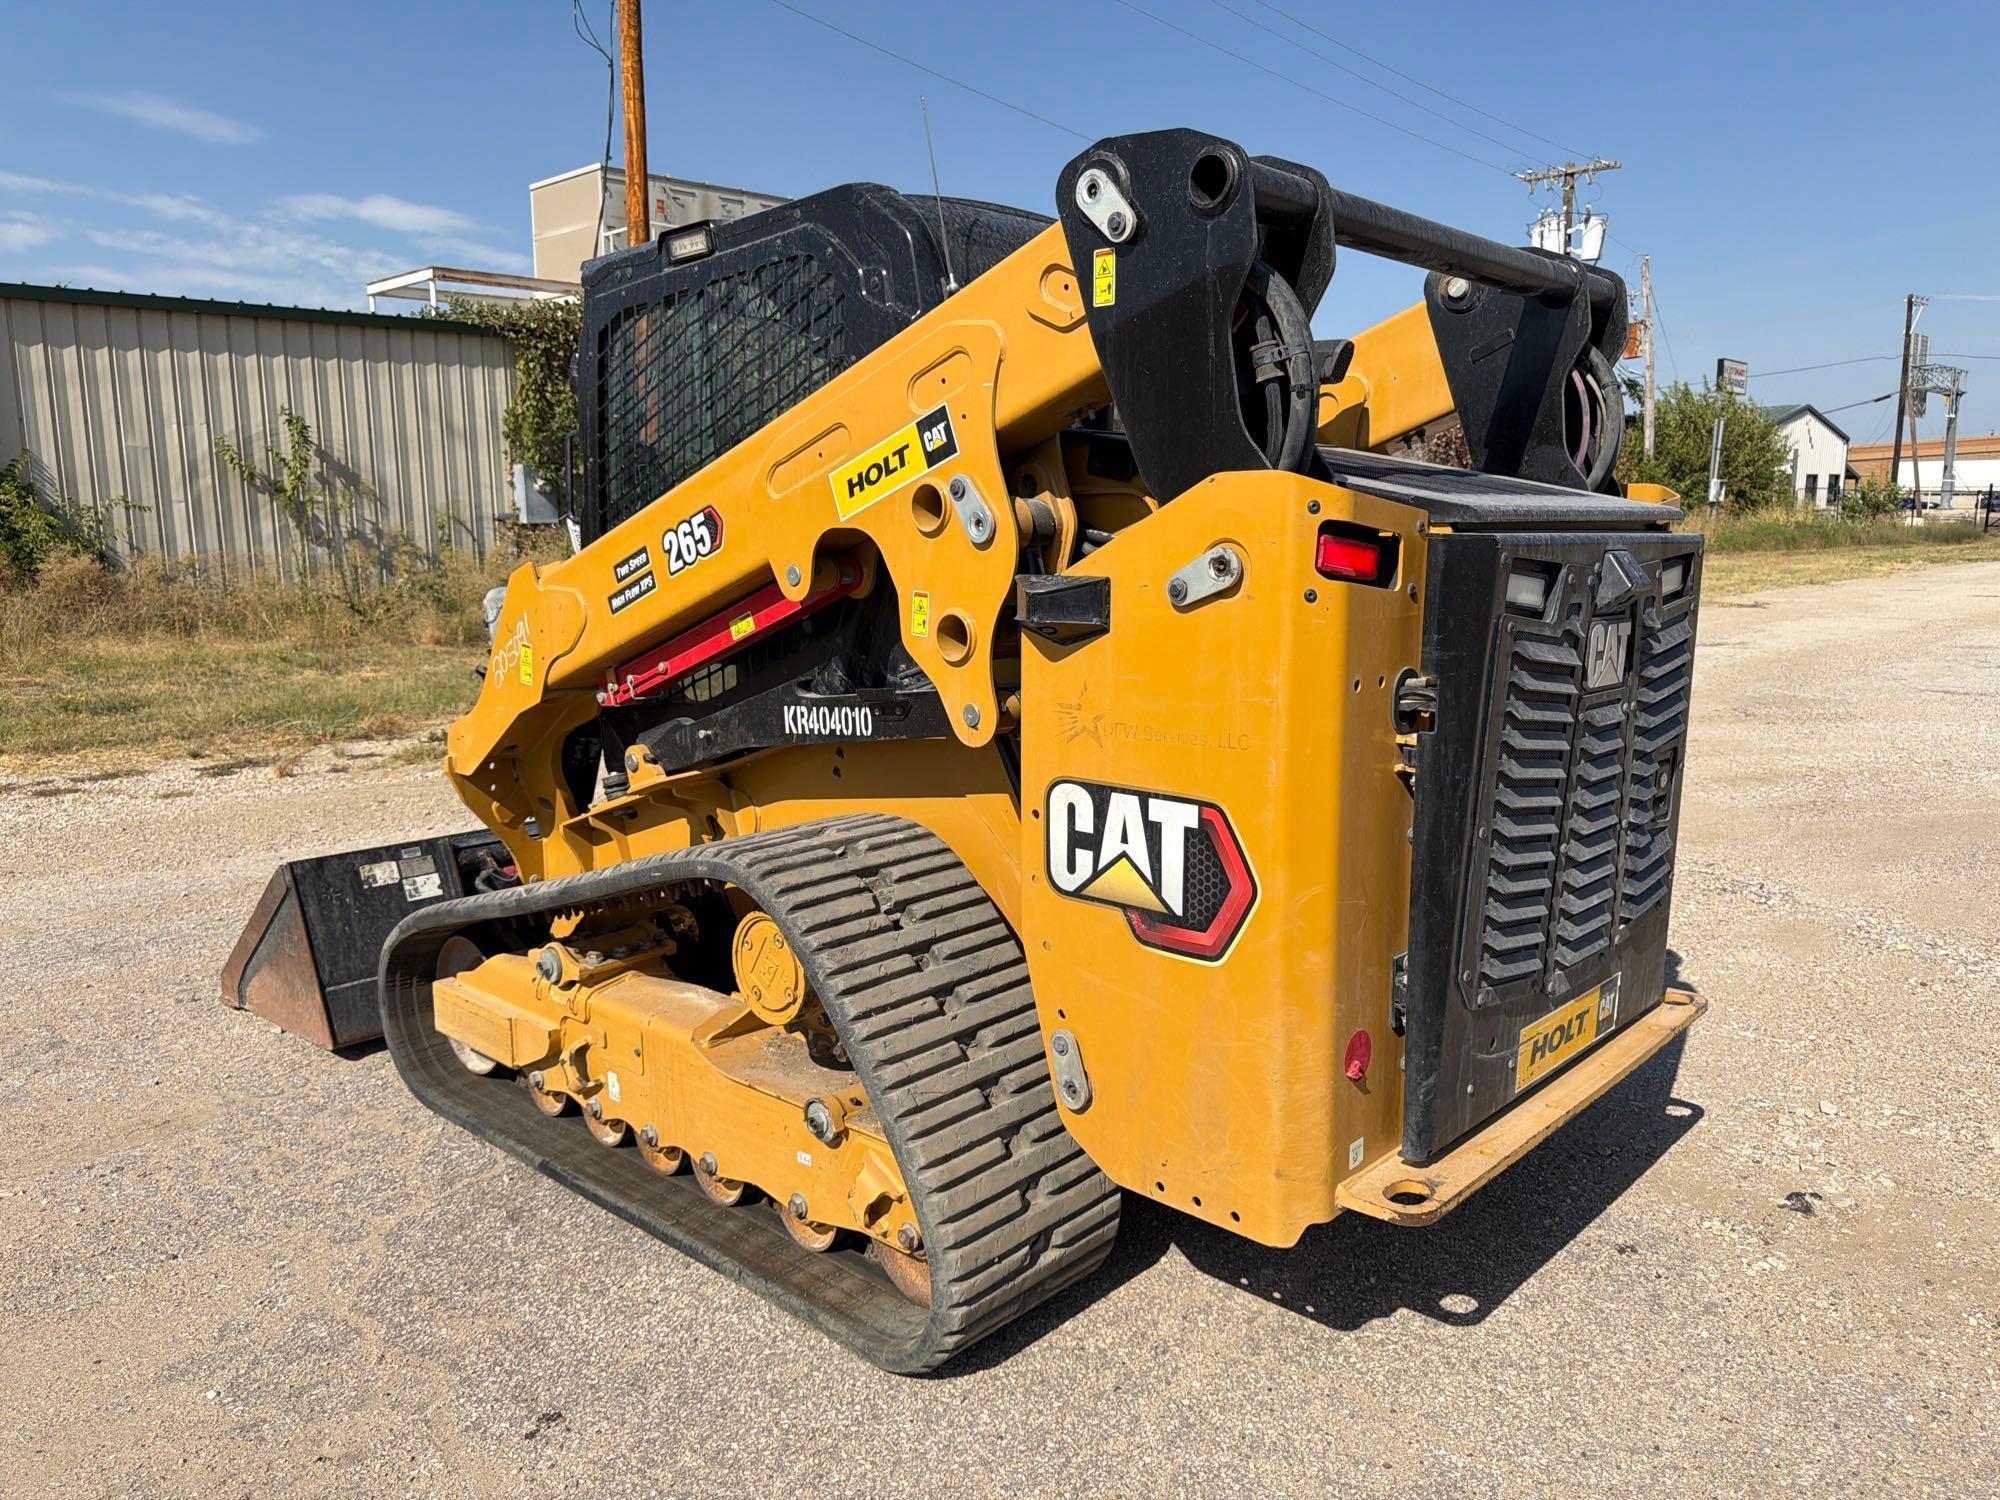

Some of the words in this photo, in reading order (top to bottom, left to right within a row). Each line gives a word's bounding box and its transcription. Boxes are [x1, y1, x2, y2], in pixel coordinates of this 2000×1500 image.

[846, 443, 910, 499] HOLT
[923, 421, 947, 452] CAT
[663, 511, 712, 574] 265
[639, 574, 653, 593] XPS
[1587, 623, 1632, 689] CAT
[783, 705, 873, 737] KR404010
[1217, 732, 1249, 752] LLC
[1049, 782, 1199, 918] CAT
[1529, 1006, 1592, 1067] HOLT
[1599, 993, 1615, 1022] CAT
